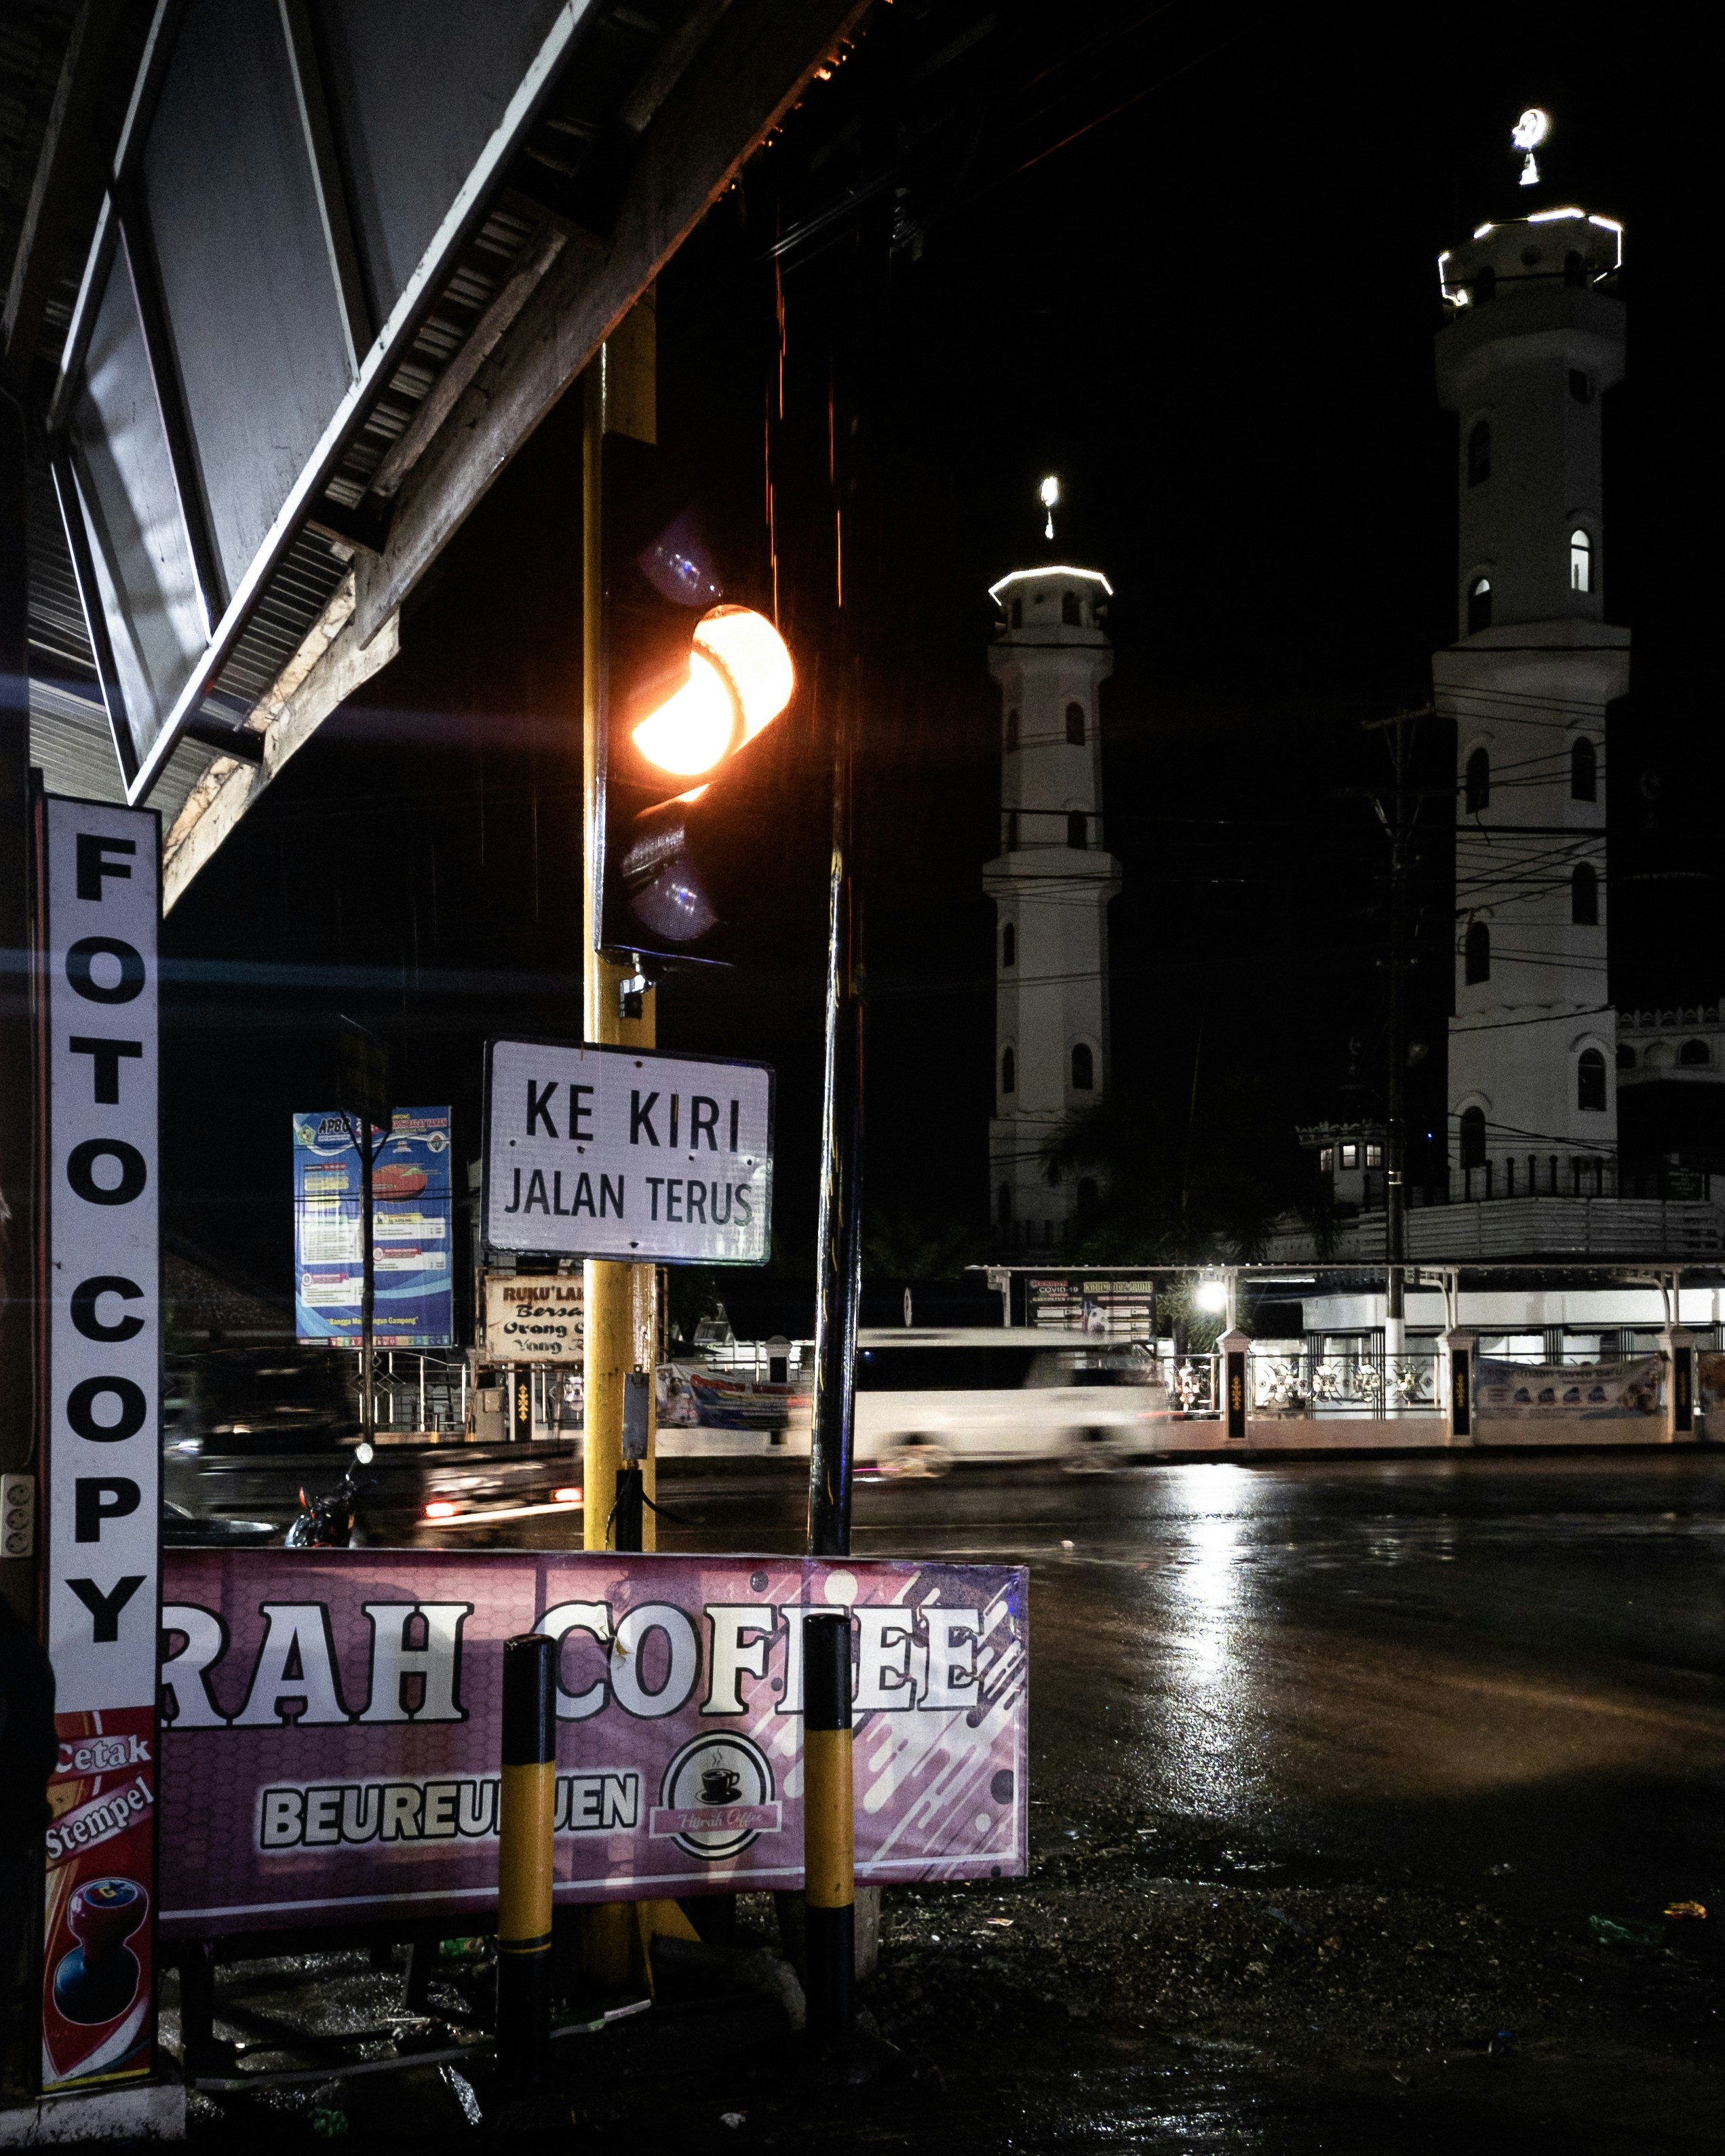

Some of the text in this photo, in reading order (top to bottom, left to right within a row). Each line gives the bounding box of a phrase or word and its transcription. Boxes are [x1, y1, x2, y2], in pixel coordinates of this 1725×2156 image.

[526, 1079, 739, 1153] KE KIRI
[505, 1167, 752, 1227] JALAN TERUS
[64, 832, 147, 1643] FOTO COPY
[504, 1322, 567, 1338] Orang
[56, 1734, 152, 1773] Cetak
[45, 1776, 155, 1860] Stempel
[260, 1771, 639, 1850] BEUREUEN
